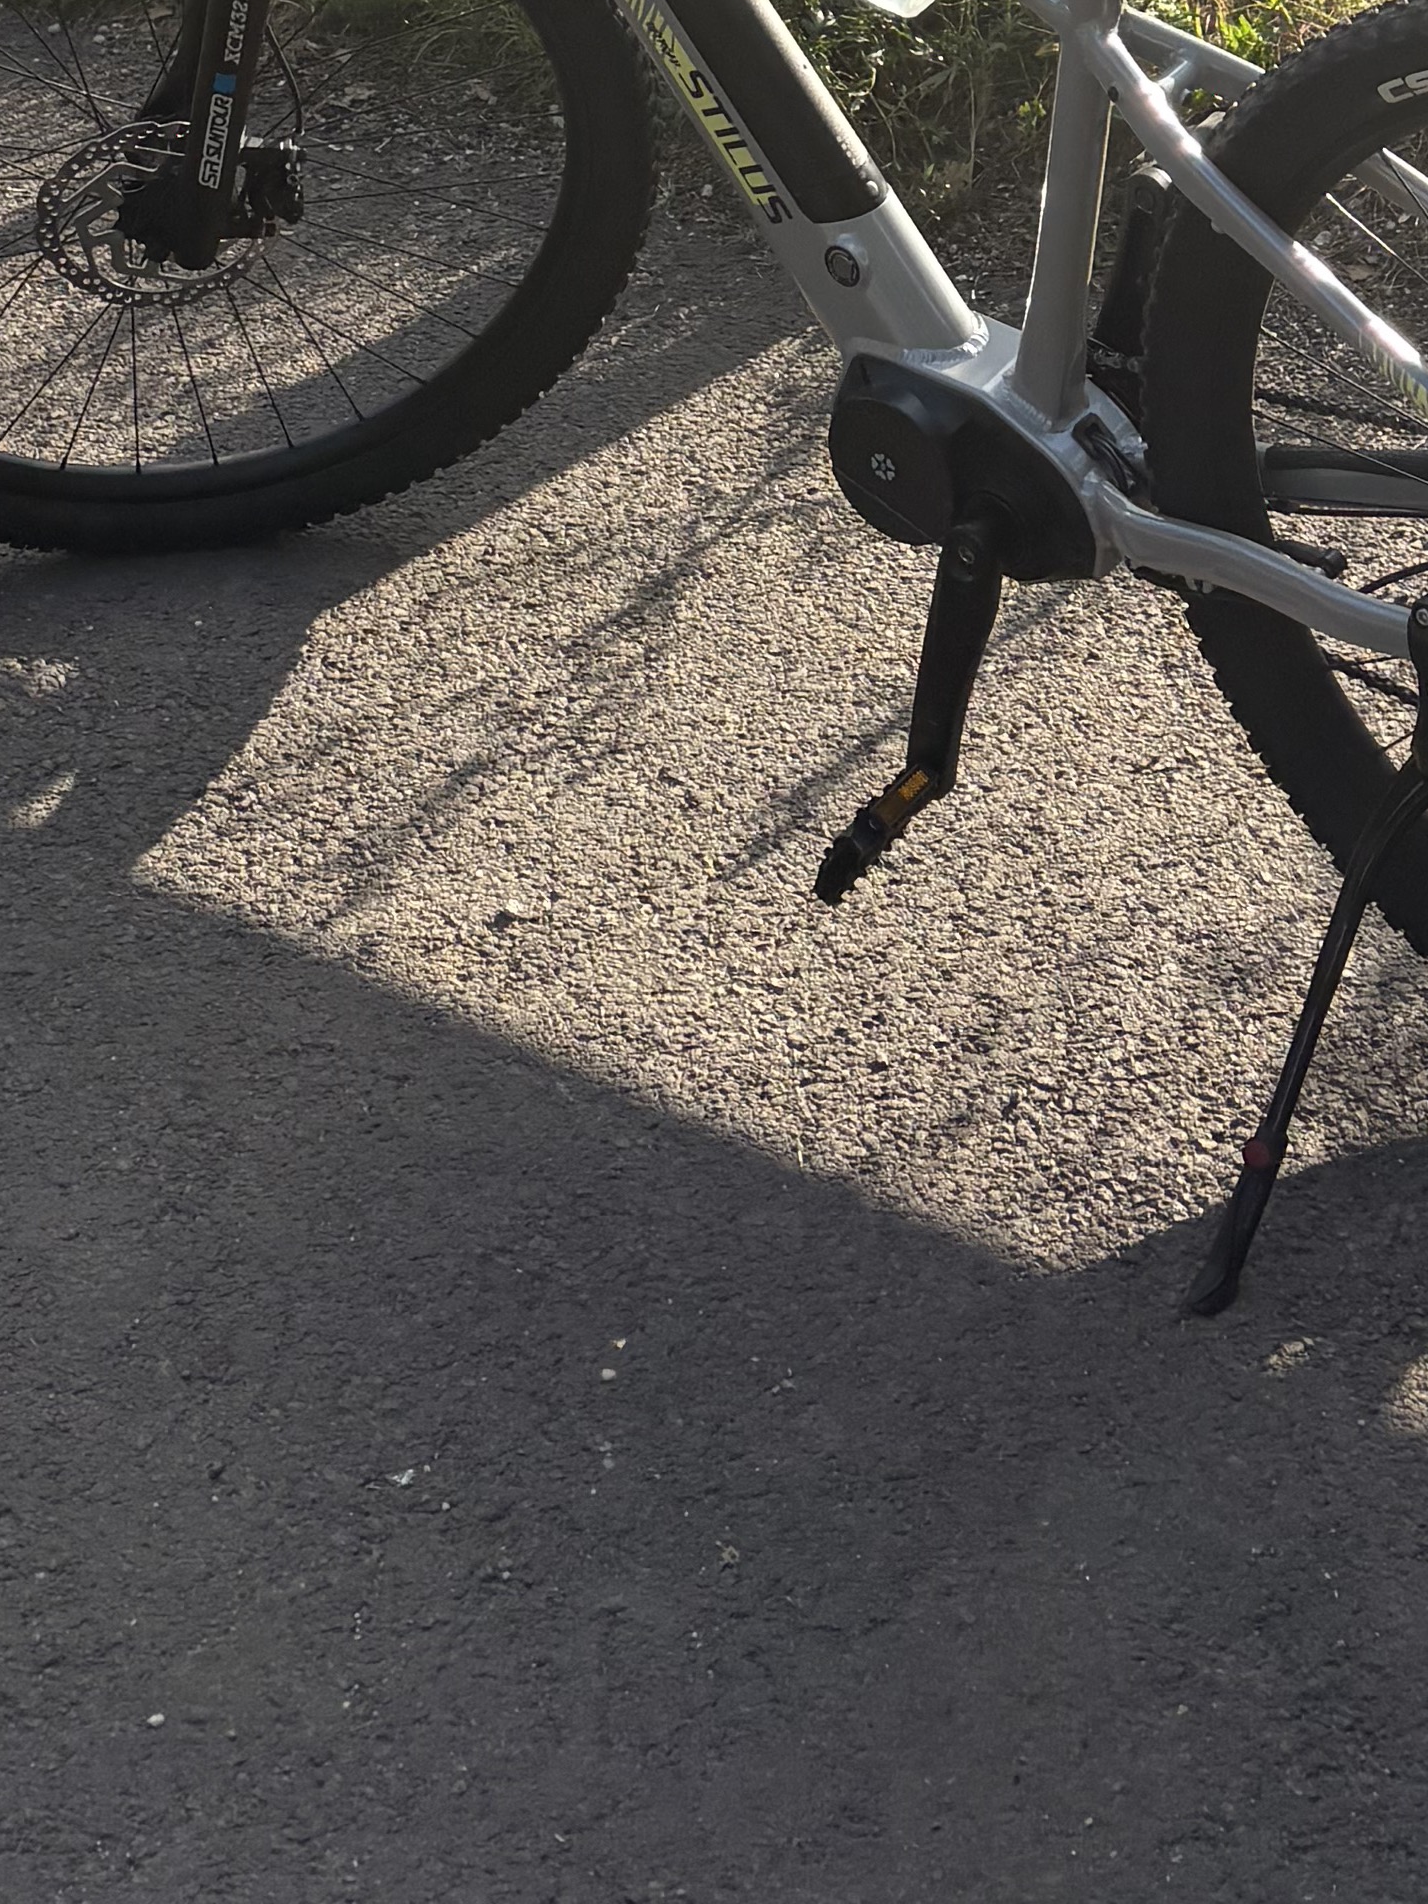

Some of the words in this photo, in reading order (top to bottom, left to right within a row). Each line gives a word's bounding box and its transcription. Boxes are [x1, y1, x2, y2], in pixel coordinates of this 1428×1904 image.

[224, 0, 248, 65] XCM32
[206, 95, 232, 158] SUNTOUR
[678, 70, 793, 224] STILUS
